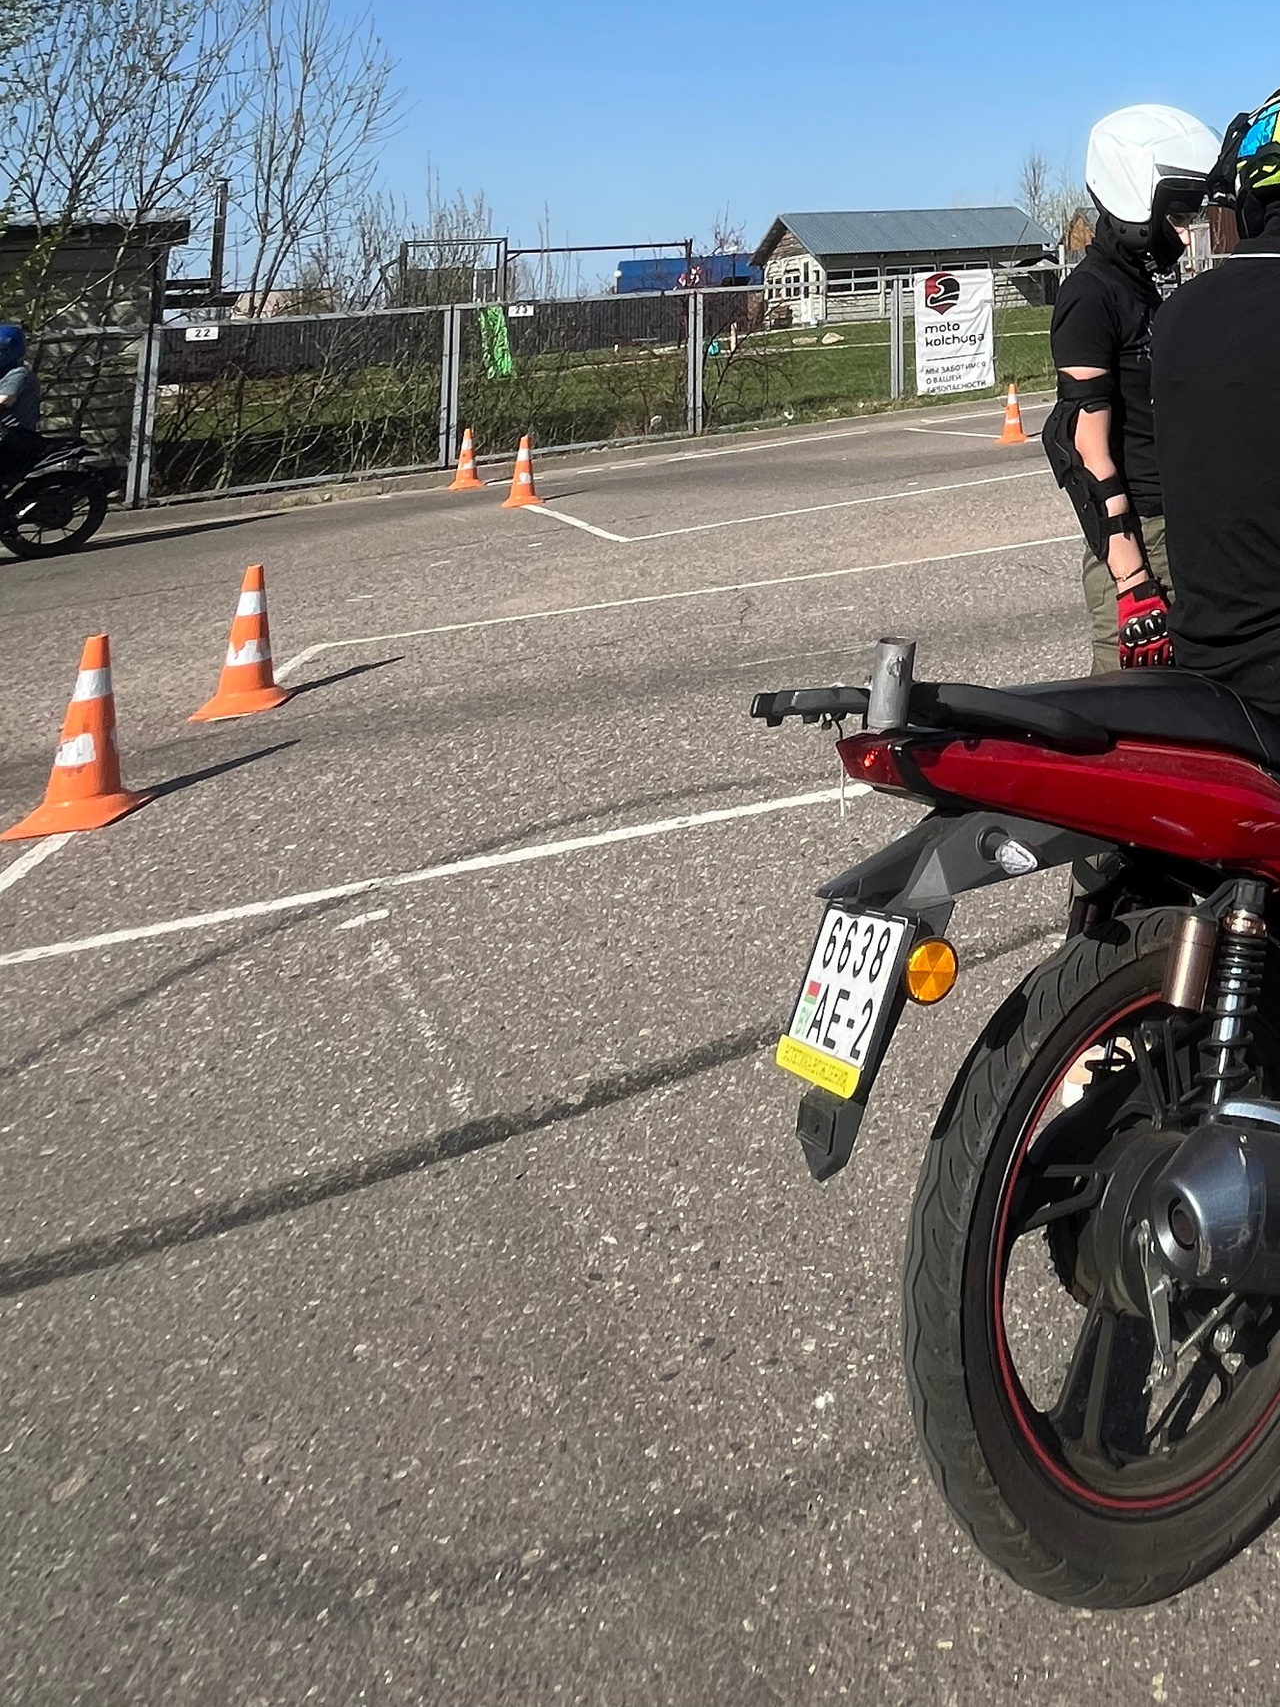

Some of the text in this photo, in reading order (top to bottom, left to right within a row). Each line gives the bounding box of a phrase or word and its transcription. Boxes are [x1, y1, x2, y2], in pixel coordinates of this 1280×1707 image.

[194, 328, 211, 338] 22
[925, 322, 960, 334] moto
[925, 334, 985, 347] kolchuga
[941, 361, 987, 374] ЗАБОТИМСЯ
[822, 916, 891, 984] 6638
[805, 983, 874, 1061] AE-2
